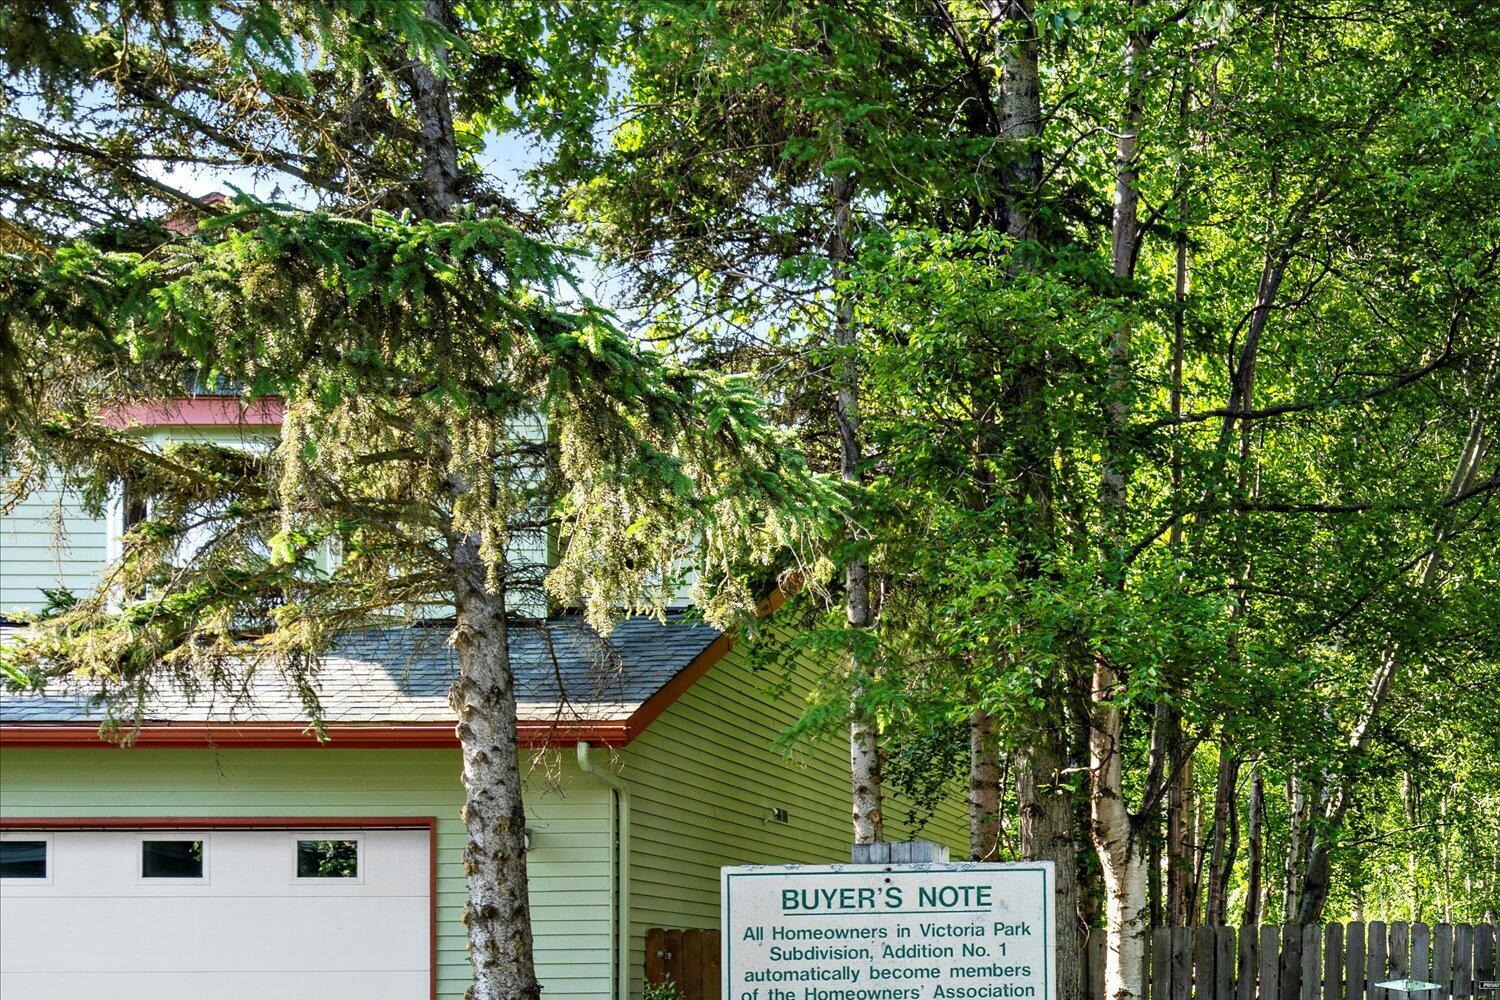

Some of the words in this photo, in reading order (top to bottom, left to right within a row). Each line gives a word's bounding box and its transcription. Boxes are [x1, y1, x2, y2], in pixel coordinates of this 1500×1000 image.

[782, 887, 903, 911] BUYER'S
[919, 886, 993, 908] NOTE
[743, 926, 764, 941] All
[773, 927, 888, 941] Homeowners
[897, 924, 911, 938] in
[920, 922, 985, 938] Victoria
[994, 922, 1032, 937] Park
[770, 945, 874, 962] Subdivision,
[882, 944, 954, 959] Addition
[963, 943, 991, 958] No.
[999, 943, 1007, 957] 1
[744, 965, 861, 983] automatically
[870, 965, 941, 980] become
[950, 963, 1031, 978] members
[934, 983, 1035, 999] Association
